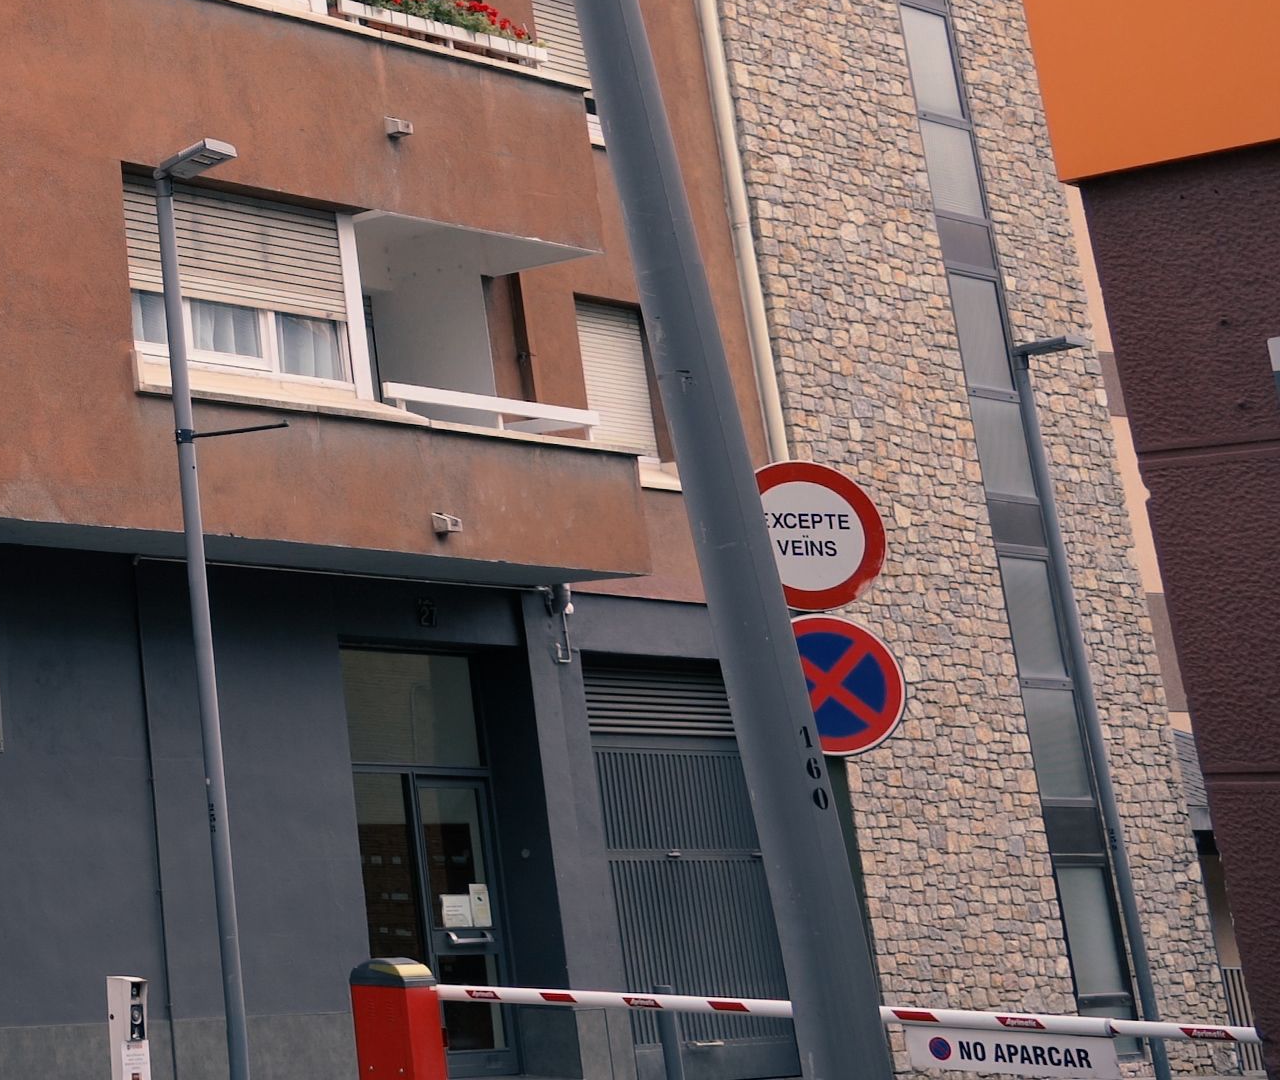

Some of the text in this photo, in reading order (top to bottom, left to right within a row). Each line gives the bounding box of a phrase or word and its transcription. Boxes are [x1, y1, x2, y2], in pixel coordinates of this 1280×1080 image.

[777, 534, 837, 557] VEÏNS
[800, 725, 828, 810] 160
[959, 1040, 1093, 1070] NO APARCAR
